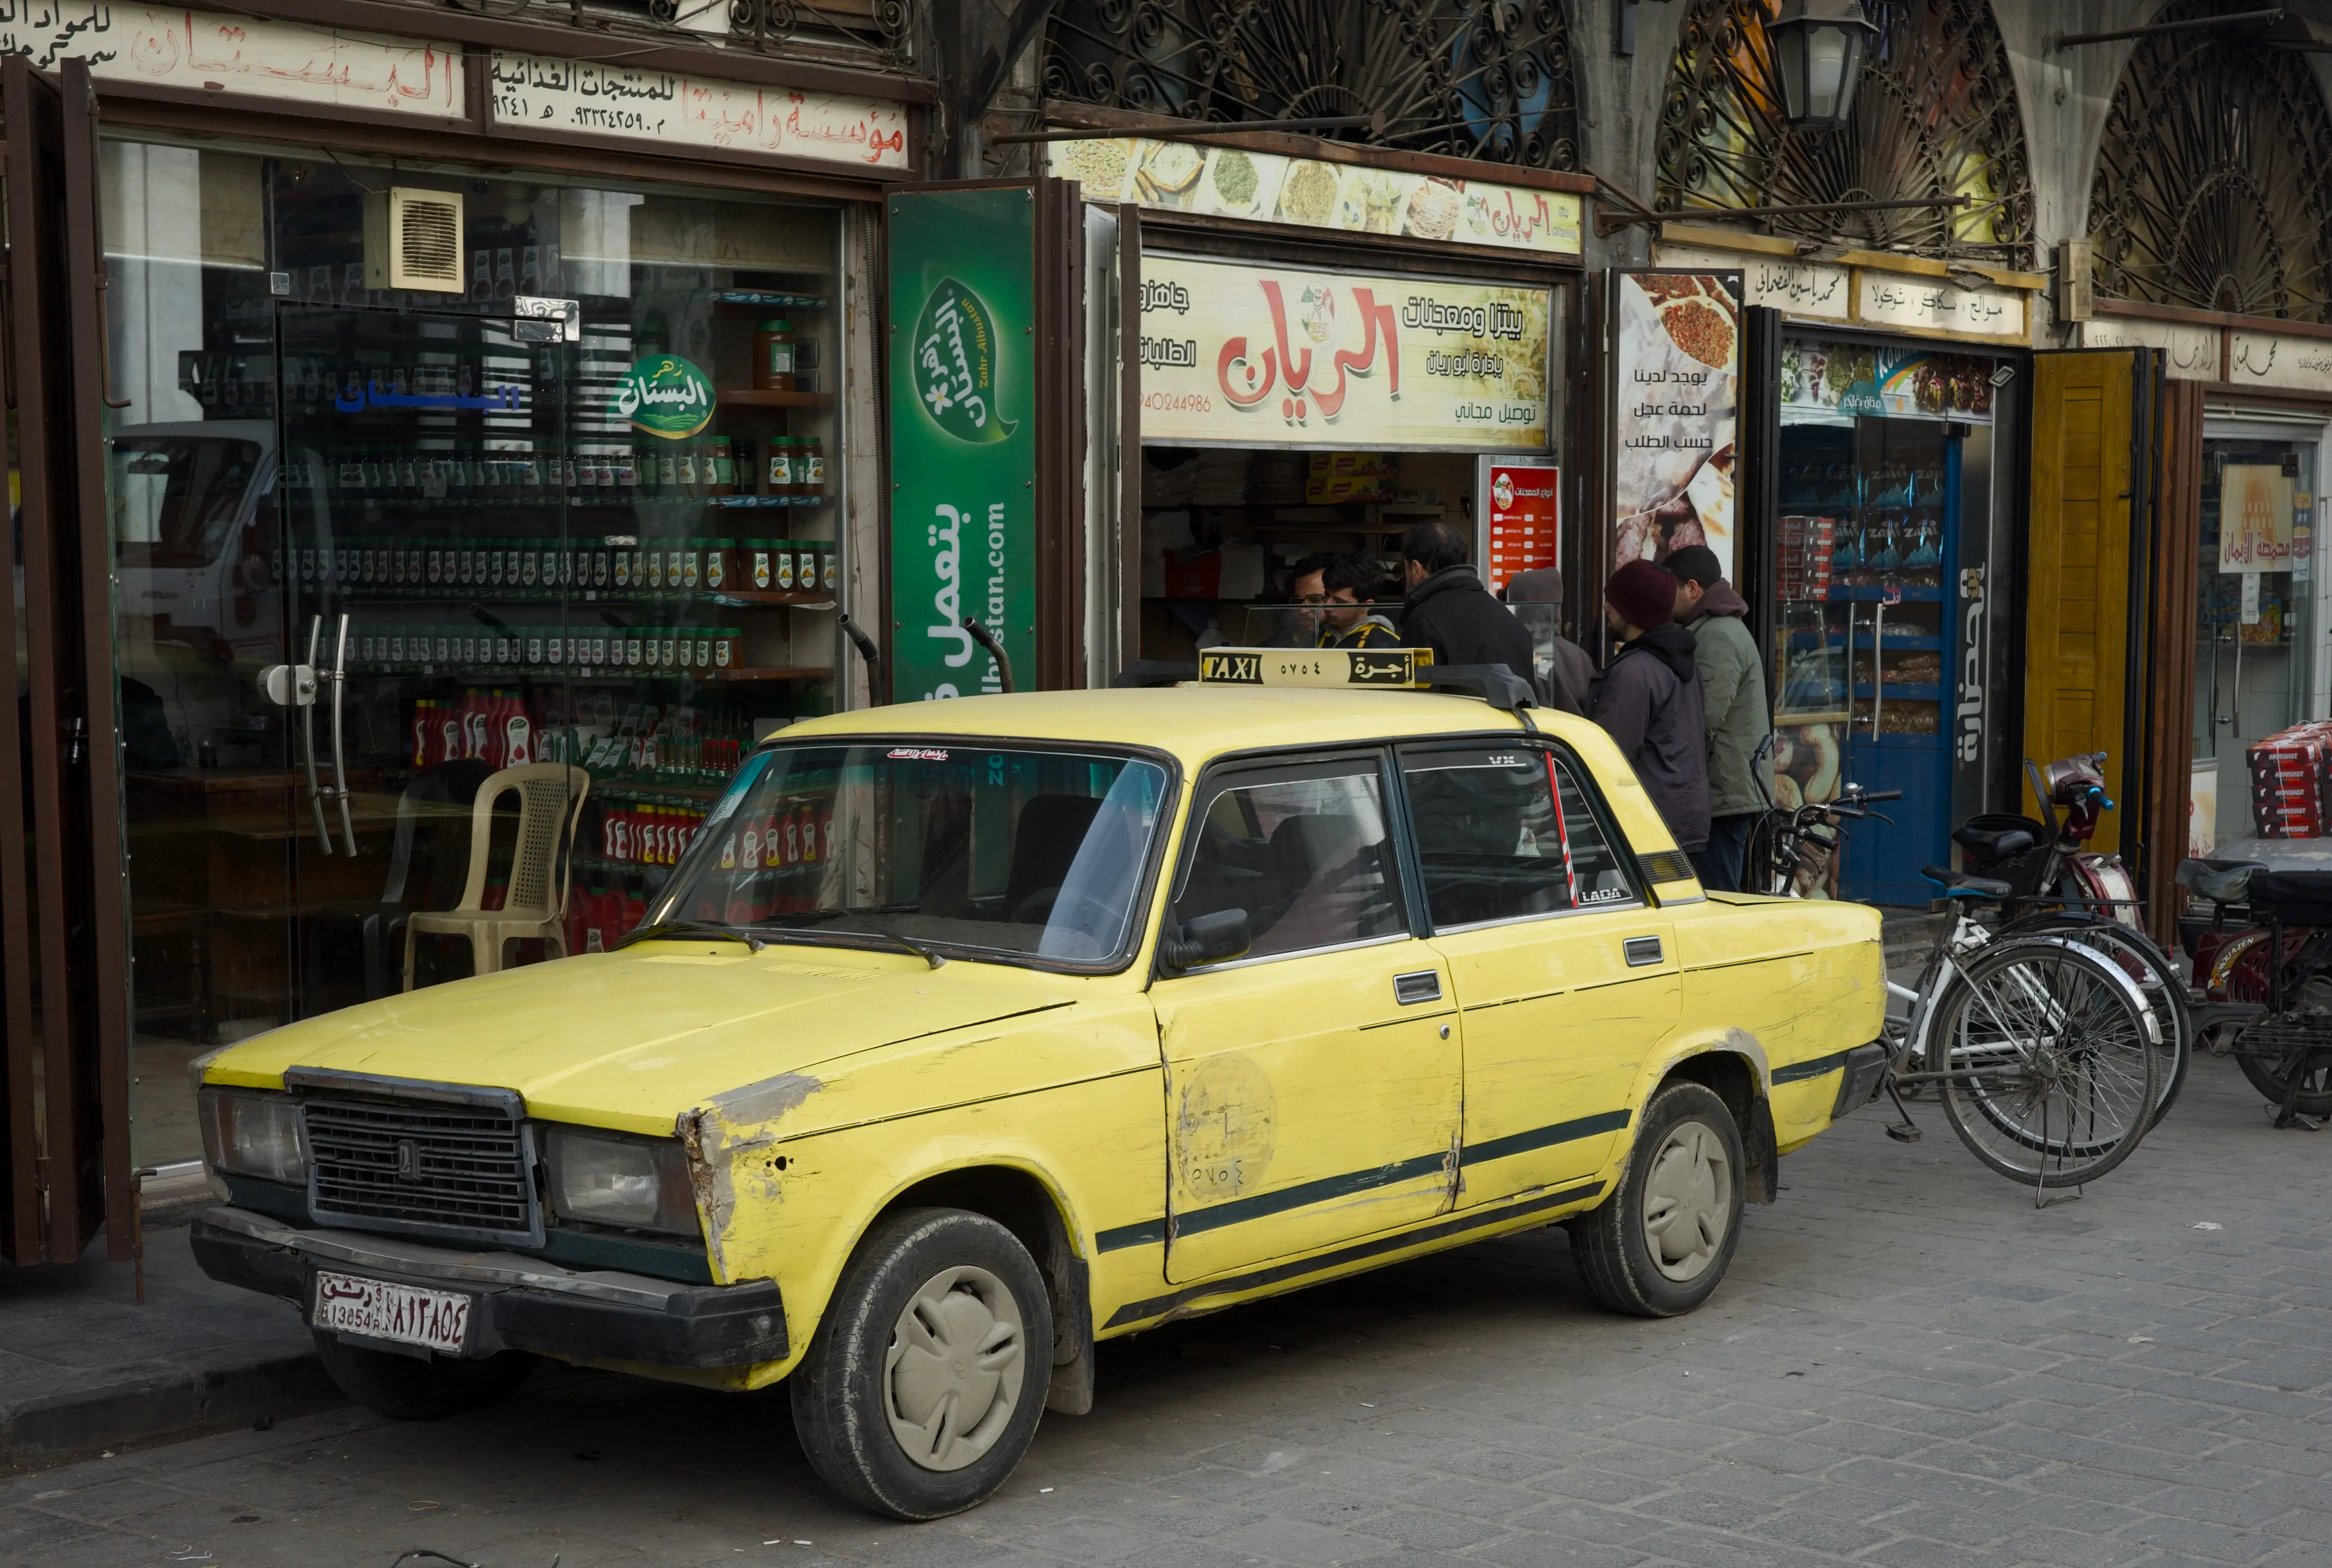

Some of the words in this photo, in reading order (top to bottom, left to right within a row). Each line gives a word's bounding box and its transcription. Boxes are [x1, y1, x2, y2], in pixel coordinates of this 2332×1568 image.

[131, 9, 452, 108] البستان
[491, 51, 577, 93] الغذائية
[580, 68, 676, 102] للمنتجات
[787, 91, 904, 163] مؤسسة
[1492, 190, 1551, 243] الريان
[1790, 271, 1817, 306] ياسين
[1817, 273, 1839, 301] محمد
[1872, 285, 1905, 310] شوكولا
[1402, 295, 1486, 338] ومعجنات
[1917, 288, 1957, 316] سكاكر
[1970, 295, 2002, 321] موالح
[960, 297, 988, 354] Albustan
[1488, 302, 1523, 341] بيتزا
[920, 332, 949, 379] زهر
[934, 296, 987, 428] البستان
[1217, 279, 1401, 423] الريان
[1426, 350, 1450, 376] ريان
[1451, 350, 1471, 376] أبو
[1471, 350, 1503, 379] بإدارة
[2233, 335, 2277, 376] محمصة
[652, 360, 683, 378] زهر
[978, 356, 989, 389] Zahr
[1633, 369, 1667, 384] لدينا
[1672, 369, 1707, 386] يوجد
[335, 379, 520, 415] البستان
[618, 375, 707, 416] البستان
[1633, 401, 1665, 418] عجل
[1668, 400, 1707, 417] لحمة
[1455, 401, 1493, 423] مجاني
[1498, 403, 1537, 425] توصيل
[1625, 434, 1671, 449] الطلب
[1673, 436, 1713, 449] حسب
[2224, 529, 2253, 565] الإيمان
[2256, 531, 2291, 563] محمصة
[927, 503, 974, 667] بتعمل
[1202, 655, 1257, 680] TAXI
[1354, 654, 1411, 682] أجرة
[1488, 756, 1515, 764] VX
[1582, 887, 1621, 902] LADA
[321, 1304, 371, 1328] 813854
[393, 1296, 467, 1344] ٨١٣٨٥٤
